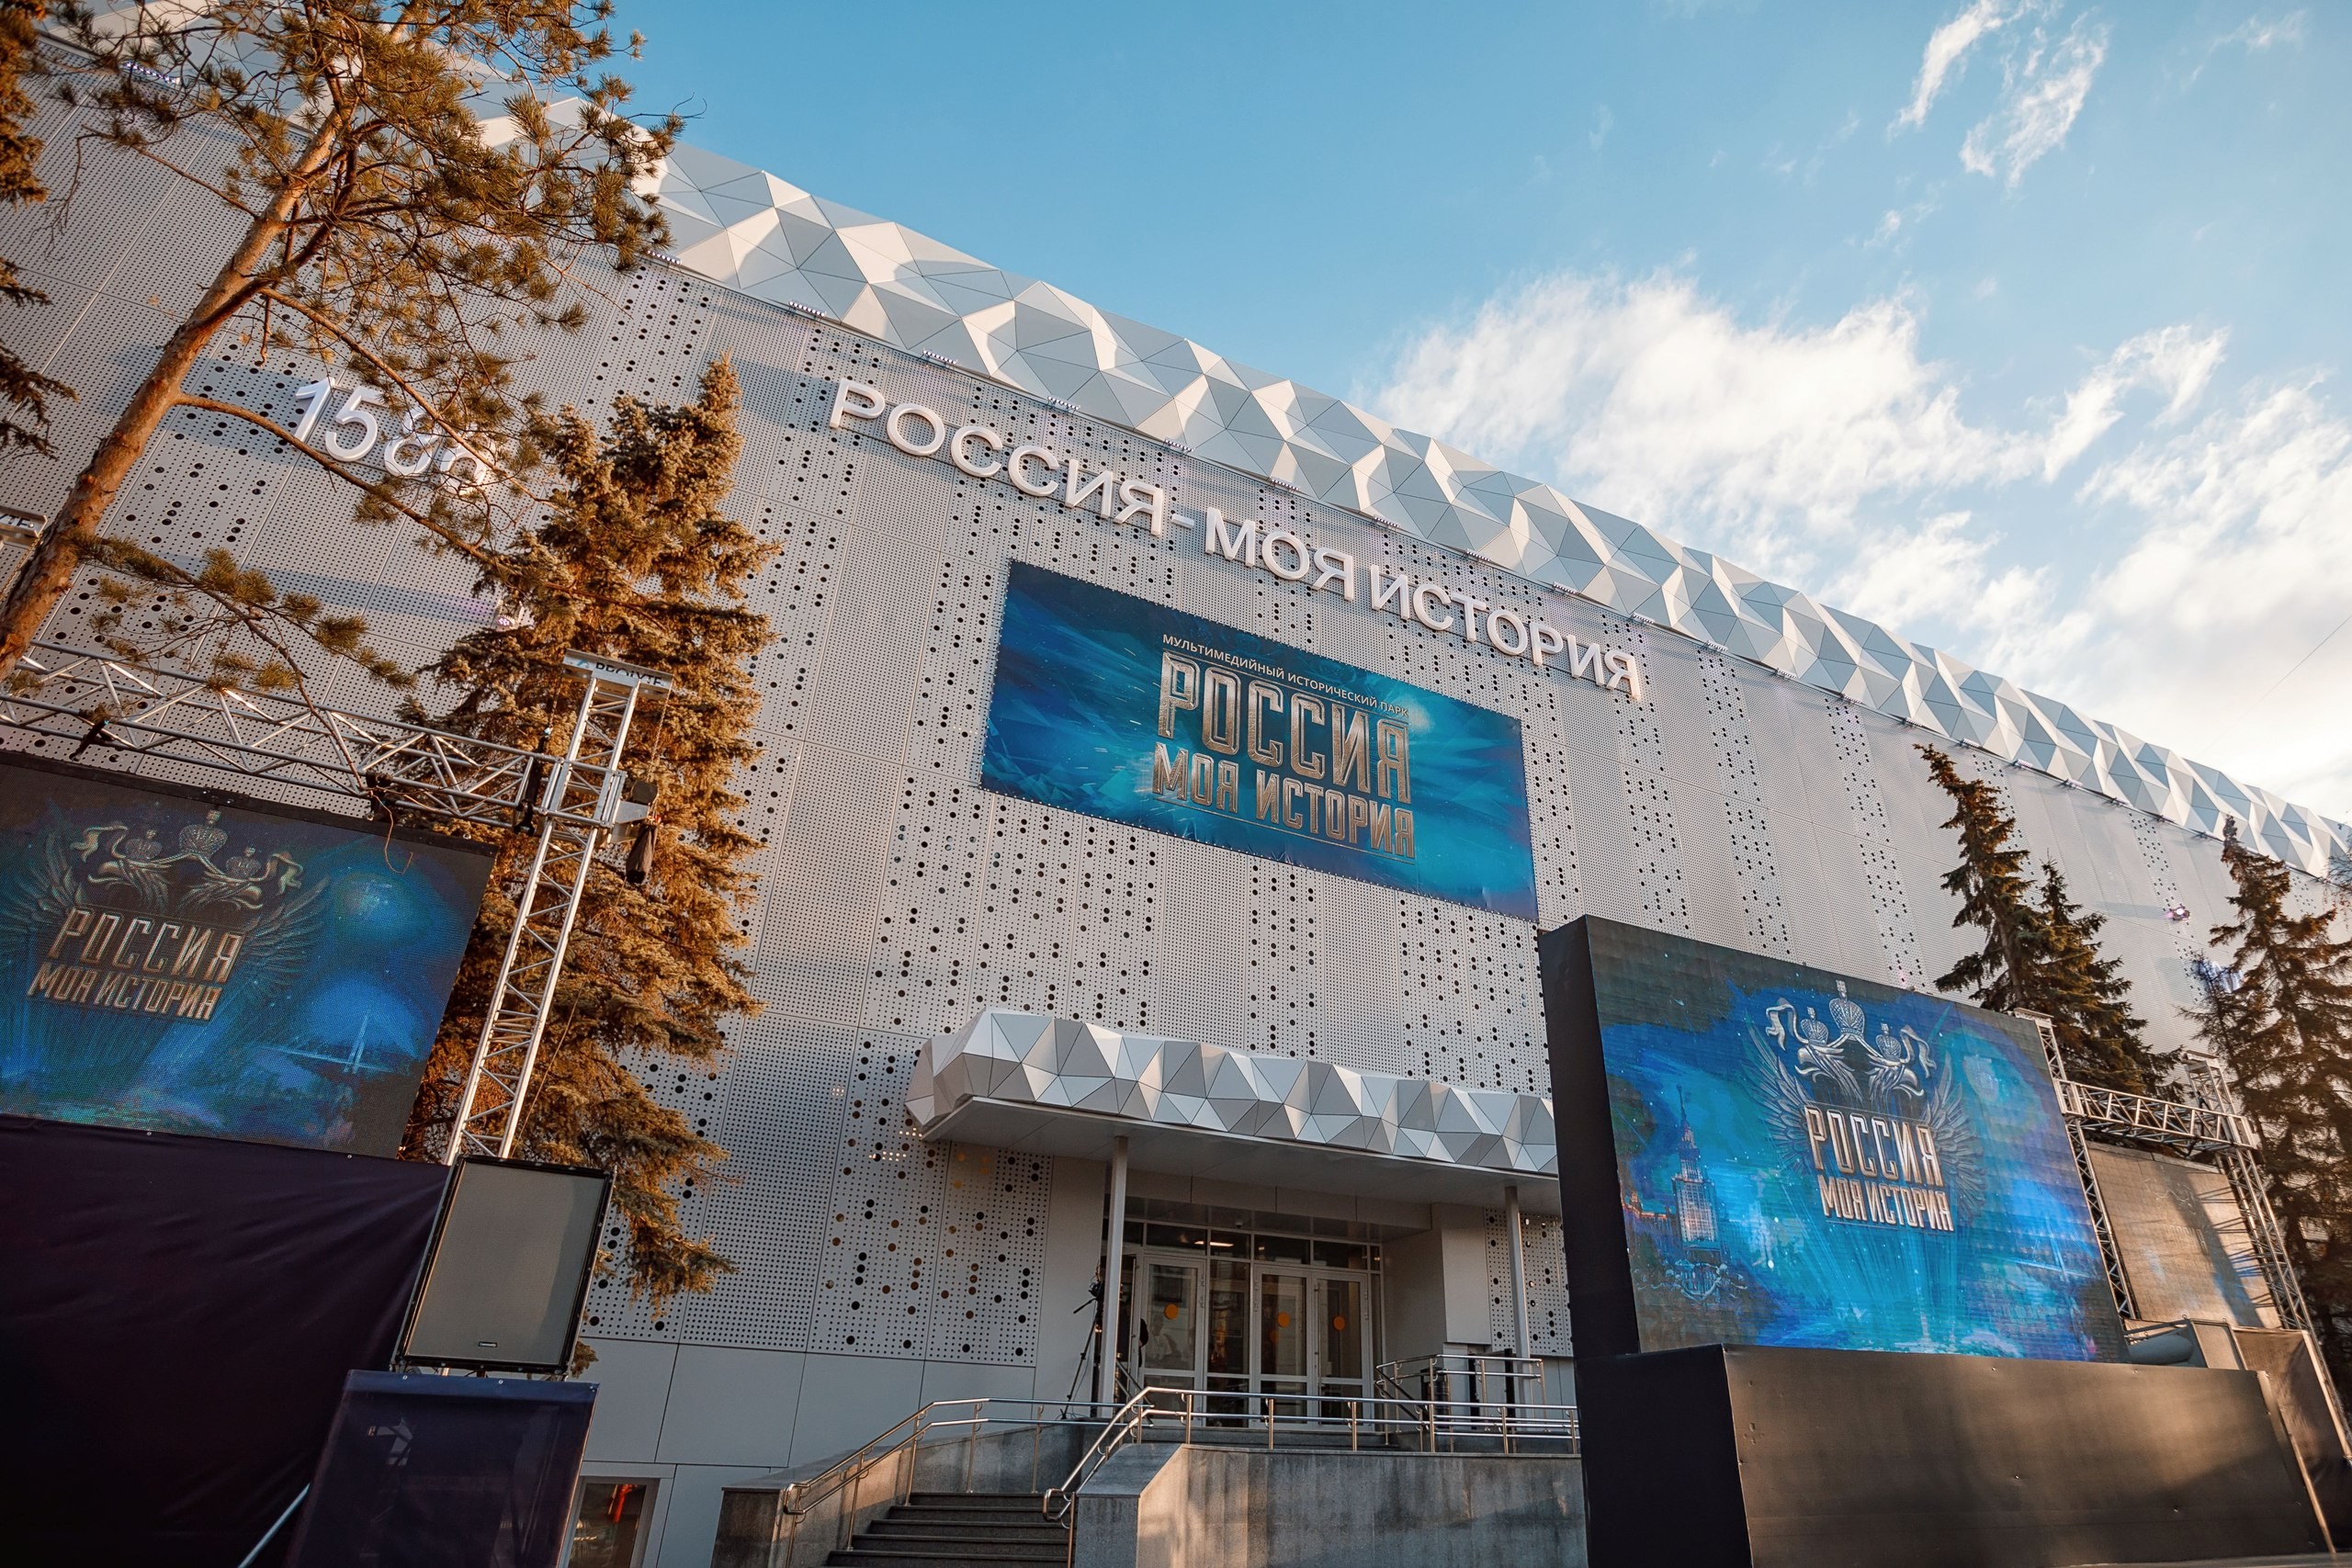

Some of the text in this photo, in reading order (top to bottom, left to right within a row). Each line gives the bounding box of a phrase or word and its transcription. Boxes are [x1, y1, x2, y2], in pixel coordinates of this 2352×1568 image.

[1204, 507, 1355, 602] МОЯ
[1370, 563, 1641, 700] ИСТОРИЯ
[1162, 633, 1408, 717] МУЛЬТИМЕДИЙНЫЙ ИСТОРИЧЕСКИЙ ПАРК
[1158, 651, 1412, 805] РОССИЯ
[1151, 741, 1416, 859] МОЯ ИСТОРИЯ
[48, 906, 245, 985] РОССИЯ
[26, 961, 223, 1021] МОЯ ИСТОРИЯ
[1804, 1104, 1945, 1188] РОССИЯ
[1816, 1173, 1955, 1233] МОЯ ИСТОРИЯ
